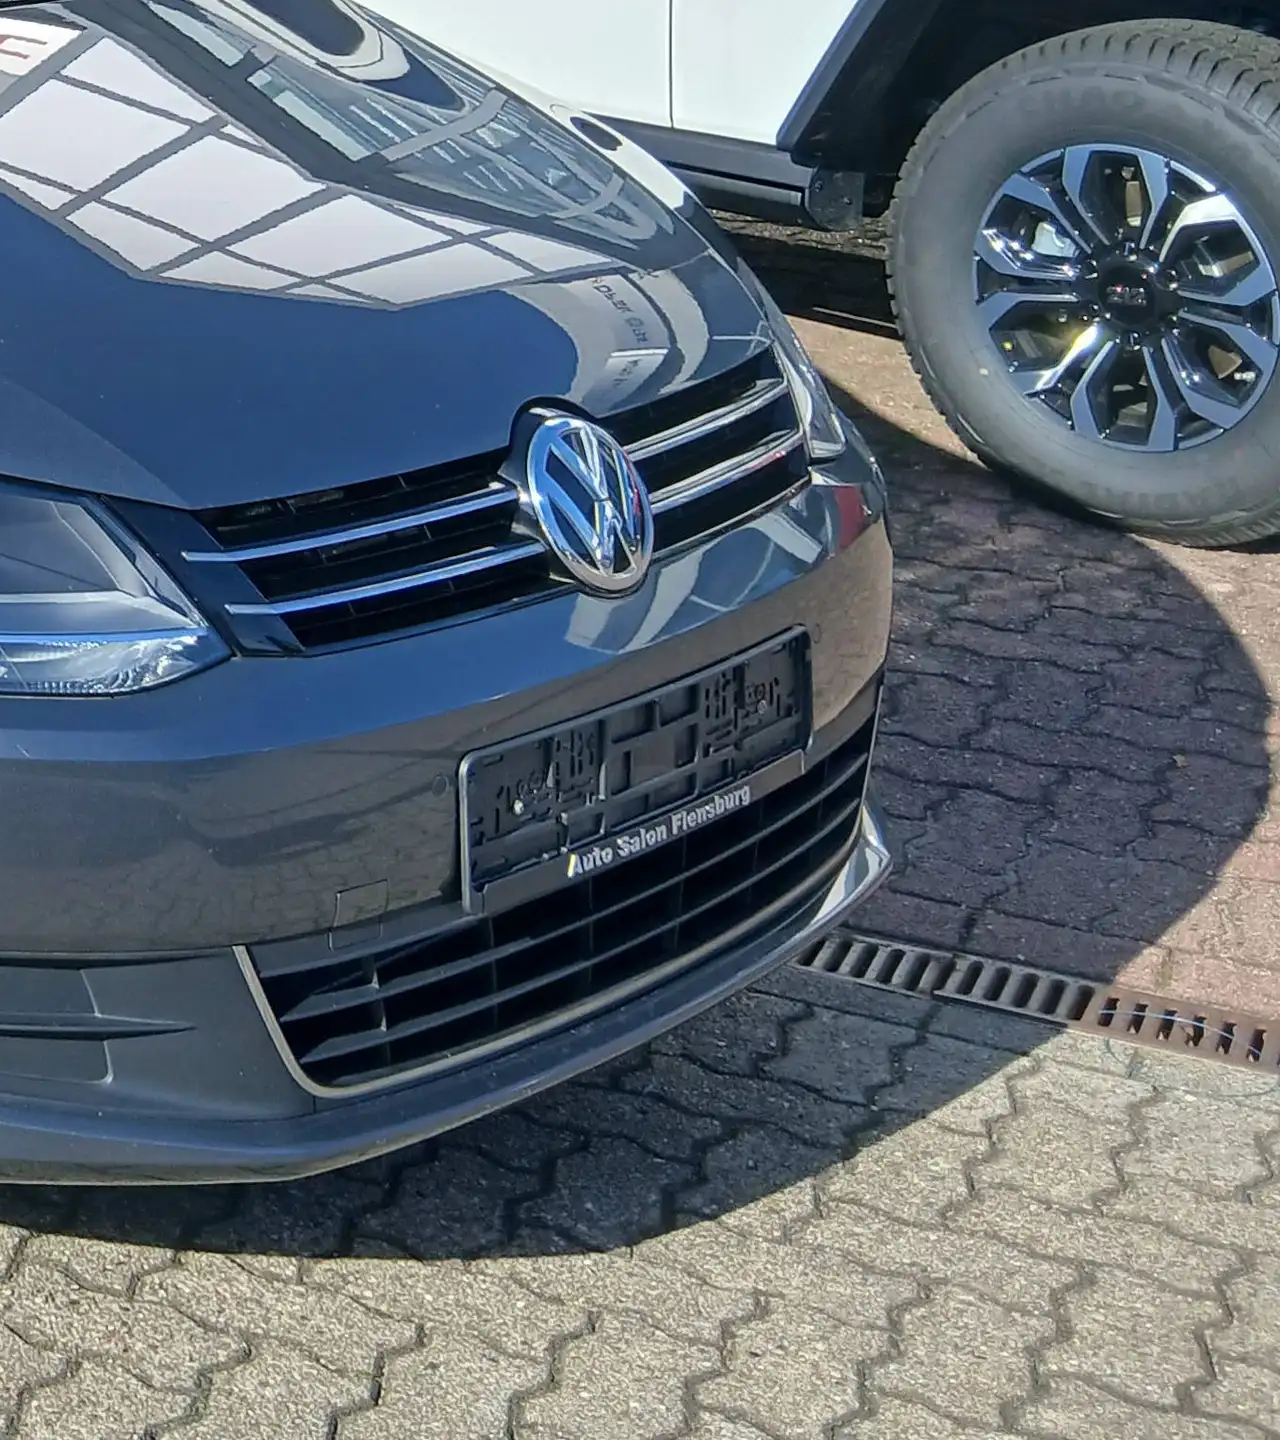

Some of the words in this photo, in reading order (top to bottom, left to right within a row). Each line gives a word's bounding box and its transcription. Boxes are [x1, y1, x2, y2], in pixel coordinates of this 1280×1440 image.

[567, 846, 613, 879] Auto
[616, 823, 668, 857] Salon
[670, 785, 751, 836] Flensburg
